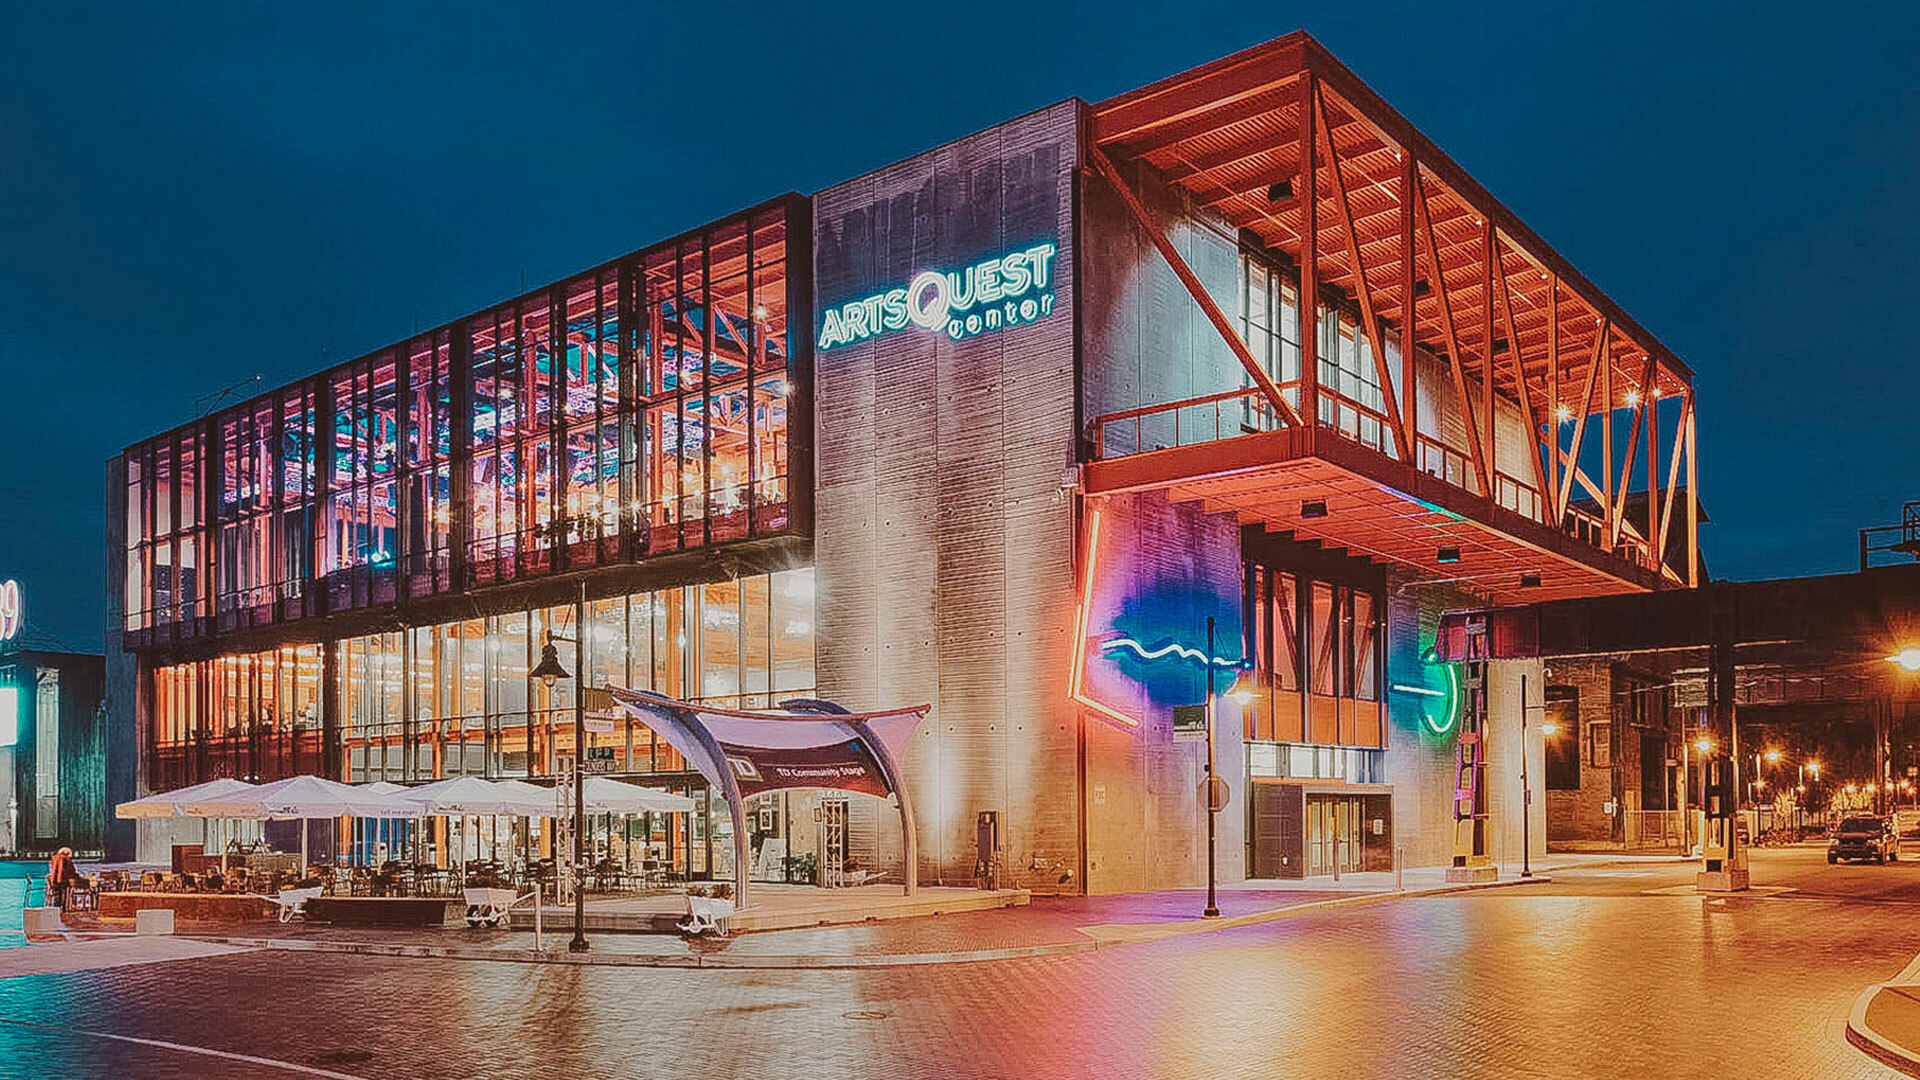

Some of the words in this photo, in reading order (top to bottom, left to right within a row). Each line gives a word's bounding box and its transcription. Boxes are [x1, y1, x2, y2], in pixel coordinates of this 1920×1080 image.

[947, 293, 1055, 339] center
[727, 758, 757, 777] TD
[776, 768, 790, 777] TD
[792, 767, 840, 778] Community
[841, 766, 866, 777] Stage
